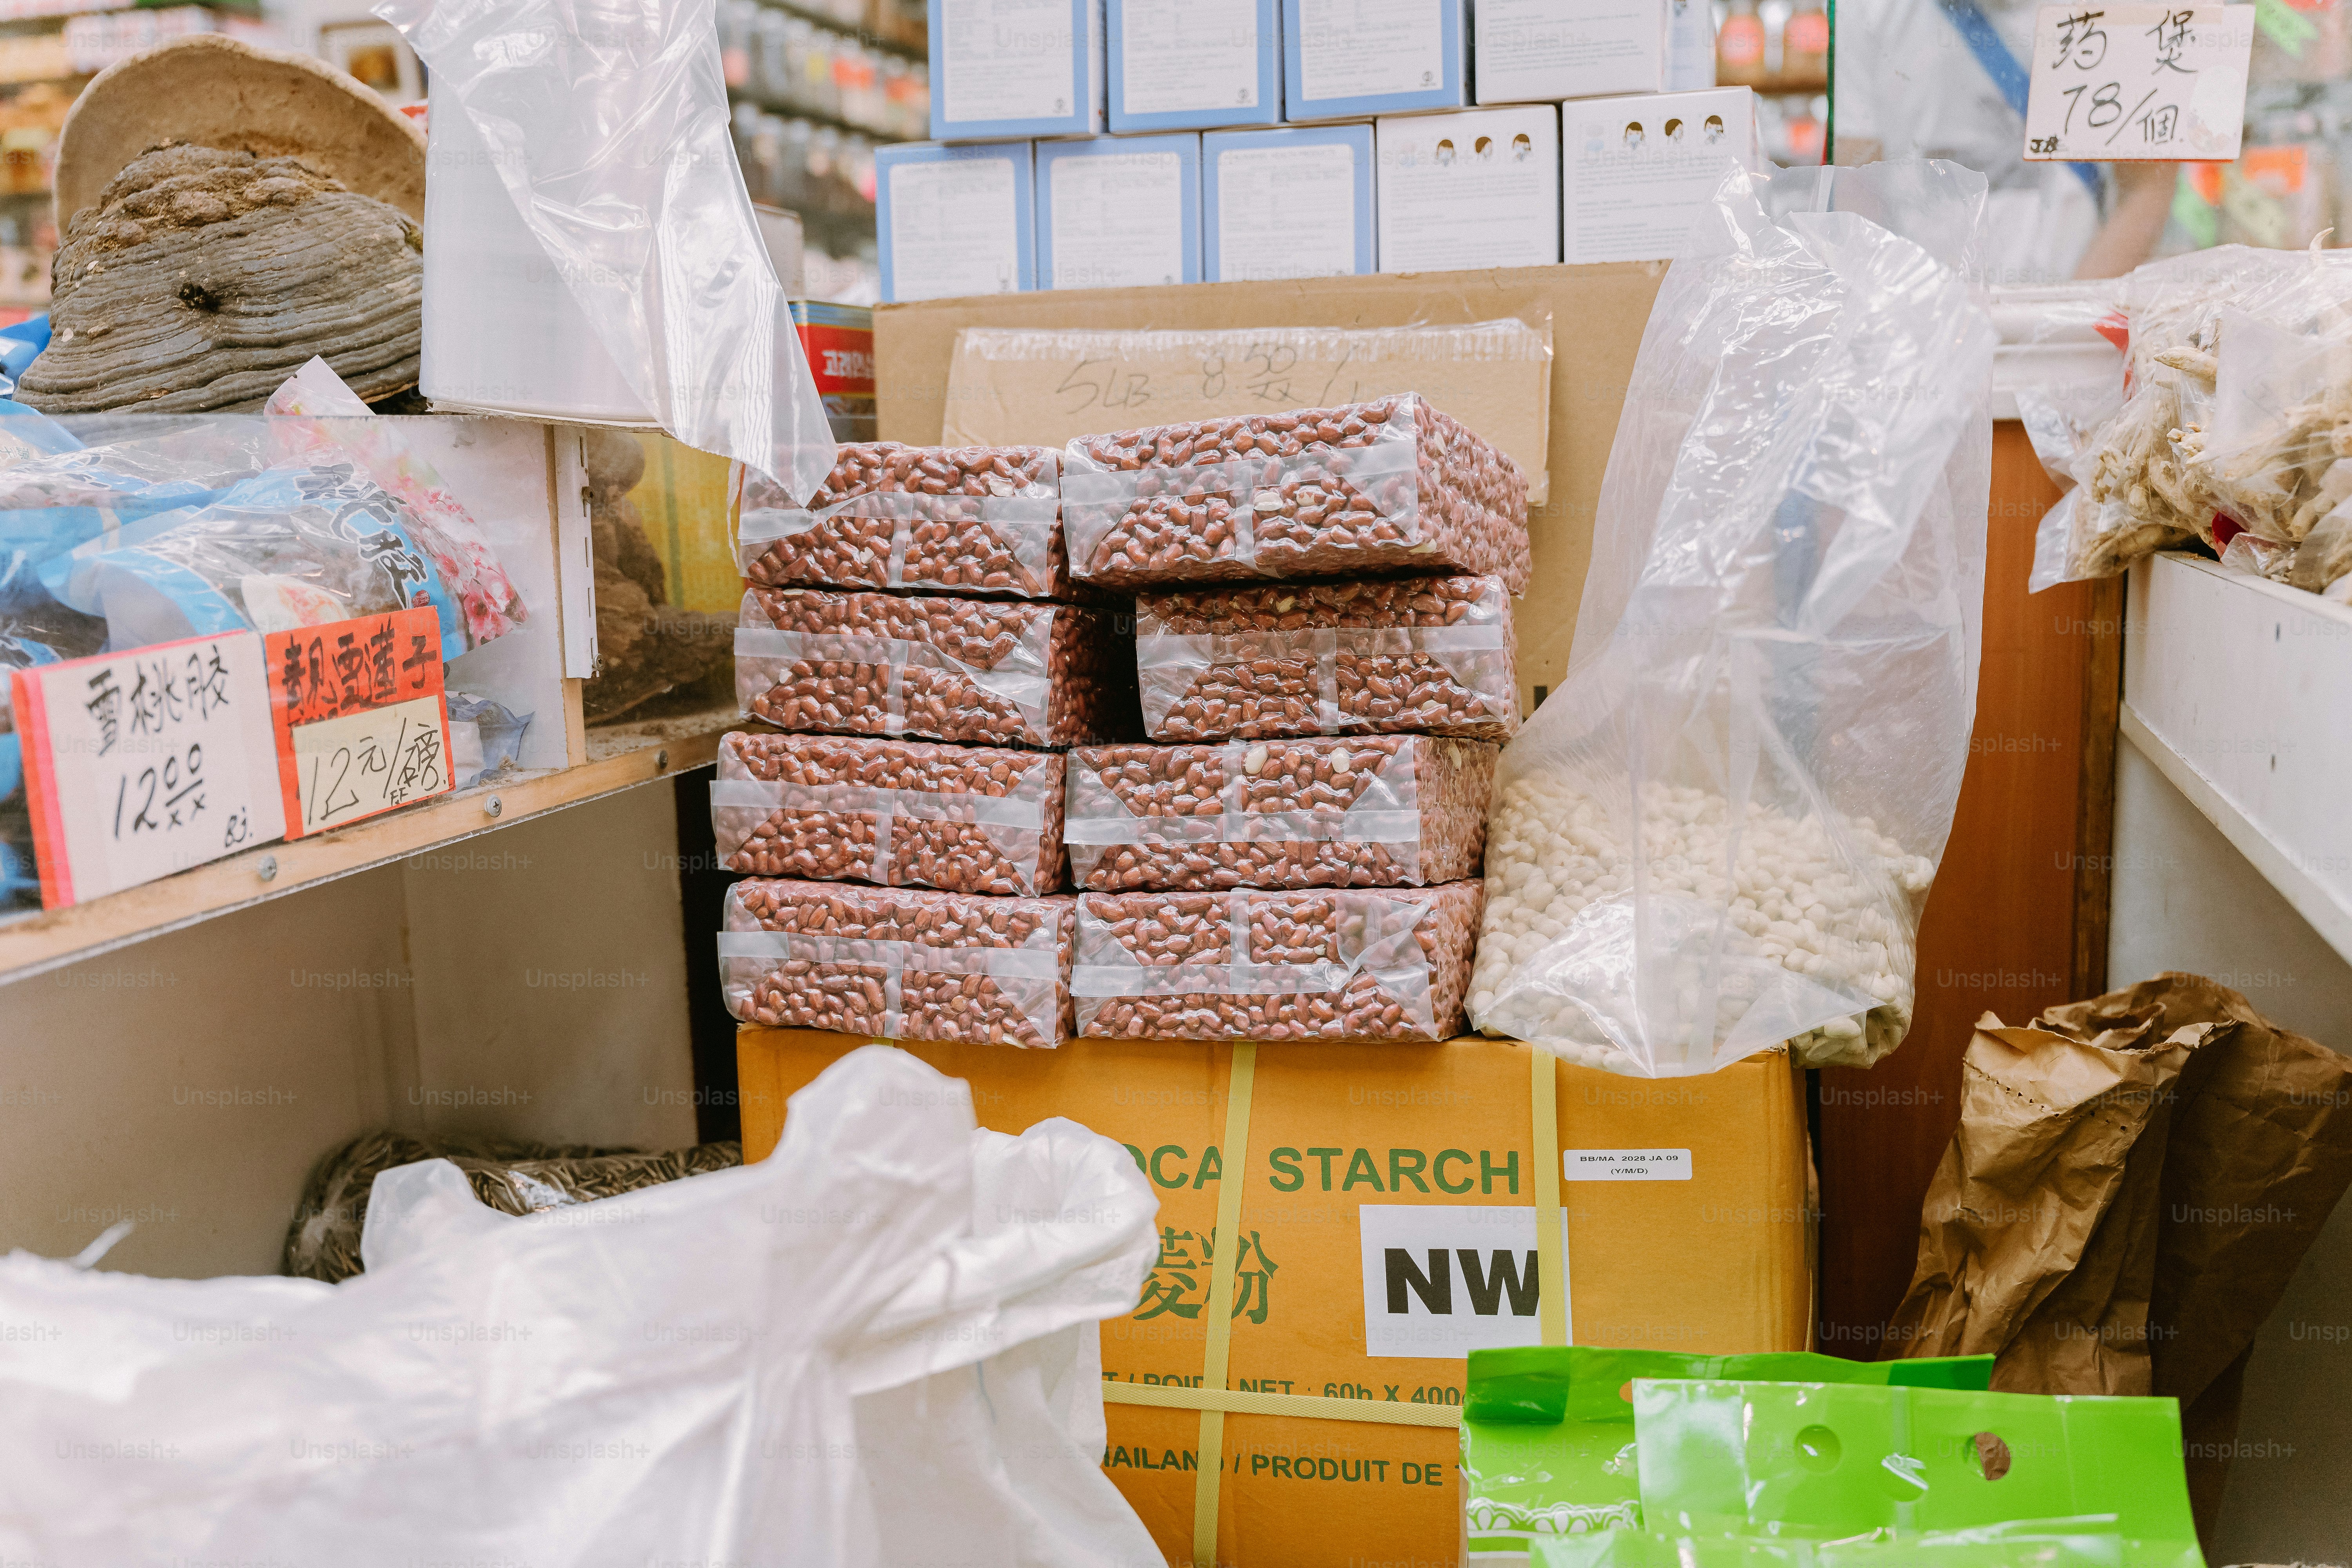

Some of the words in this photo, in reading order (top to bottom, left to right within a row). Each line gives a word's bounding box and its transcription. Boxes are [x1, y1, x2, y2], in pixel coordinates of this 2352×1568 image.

[1269, 1147, 1518, 1194] STARCH
[1385, 1248, 1540, 1316] NW
[1252, 1454, 1390, 1483] PRODUIT
[1402, 1462, 1443, 1486] DE
